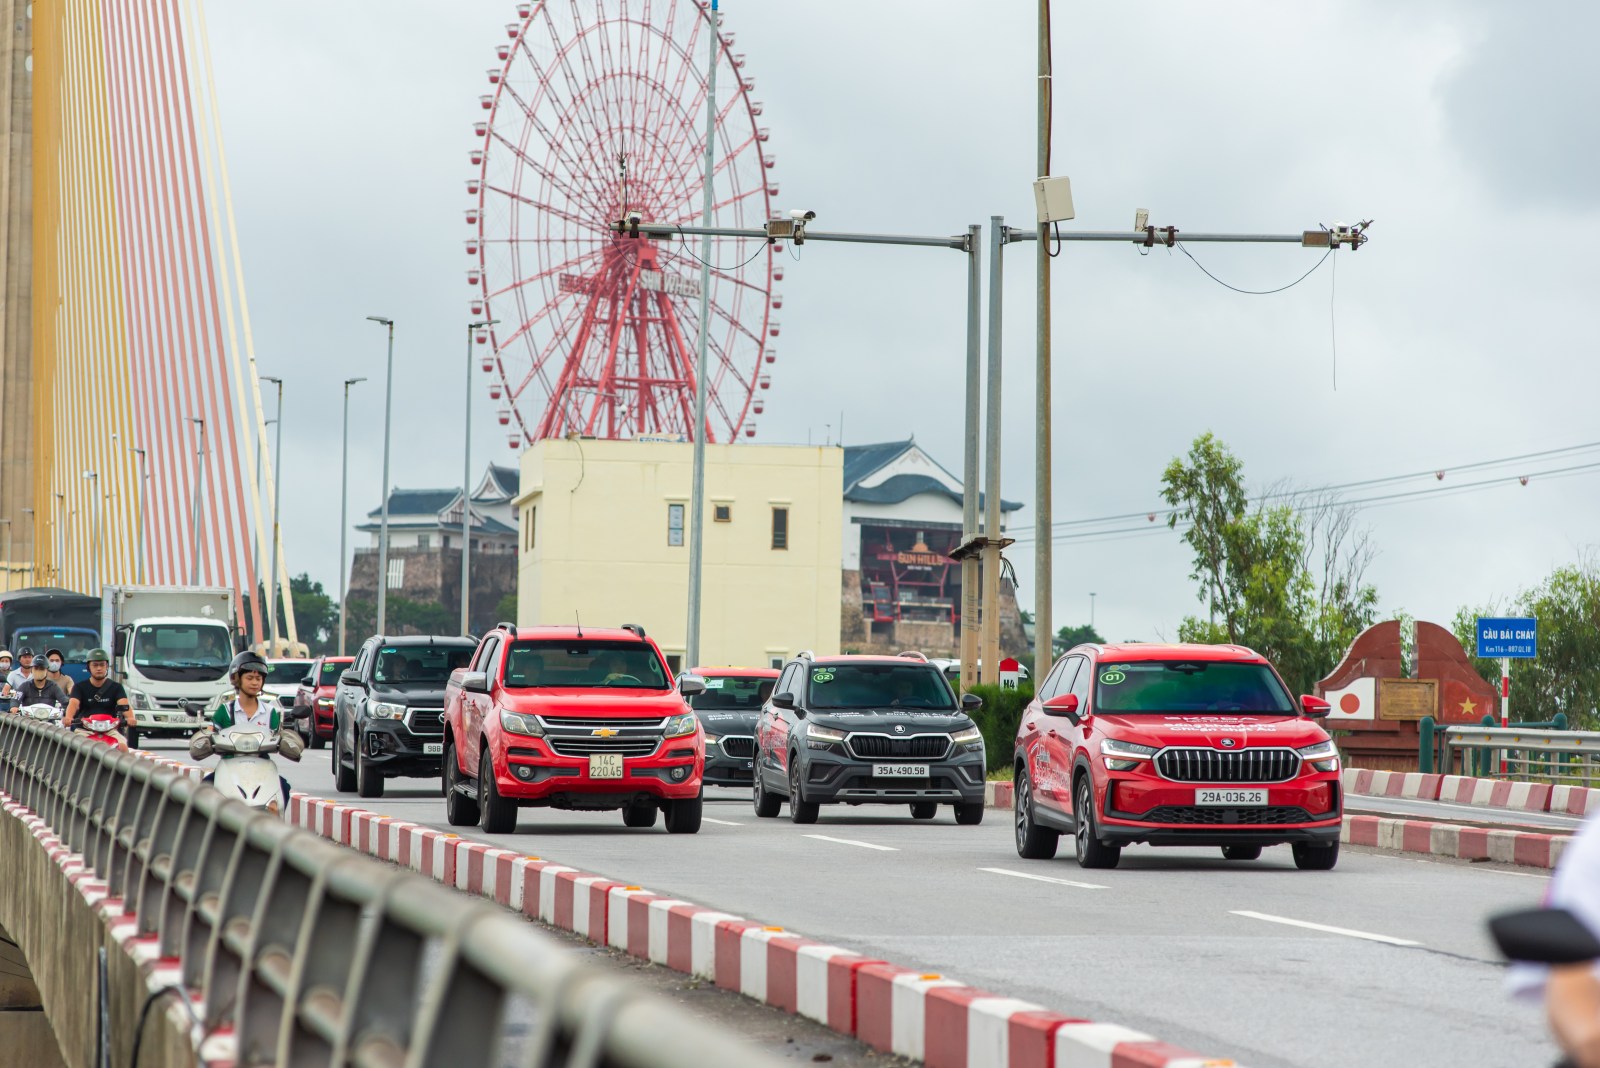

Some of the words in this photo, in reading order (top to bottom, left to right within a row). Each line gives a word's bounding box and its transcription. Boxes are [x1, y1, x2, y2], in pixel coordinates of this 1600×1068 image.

[1483, 627, 1498, 639] CẦU
[1004, 679, 1015, 689] H4
[599, 755, 615, 766] 14C
[590, 766, 622, 777] 220.45
[878, 766, 925, 775] 35A-490.58
[1201, 792, 1262, 802] 29A-036.26
